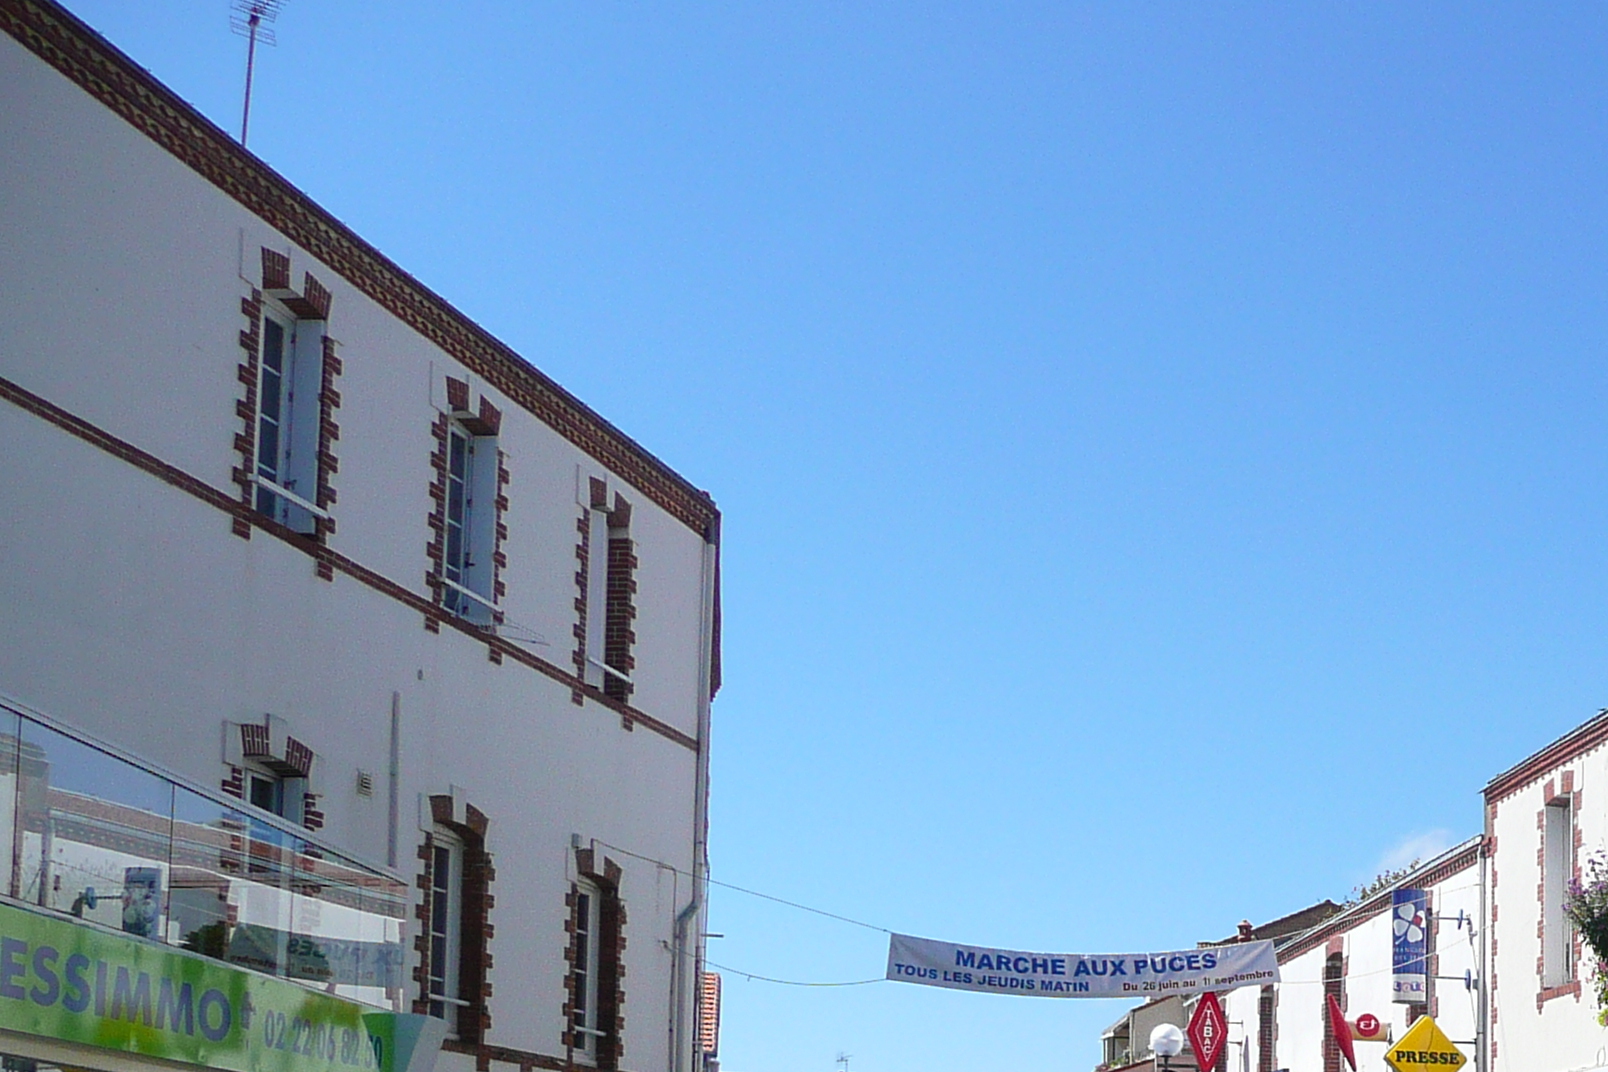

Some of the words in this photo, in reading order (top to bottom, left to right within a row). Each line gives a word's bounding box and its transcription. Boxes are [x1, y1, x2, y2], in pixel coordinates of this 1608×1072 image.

[895, 963, 939, 980] TOUS
[943, 970, 973, 984] LES
[977, 974, 1035, 990] JEUDIS
[1040, 980, 1089, 992] MATIN
[955, 950, 1066, 976] MARCHE
[1074, 959, 1127, 977] AUX
[1134, 953, 1217, 975] PUCES
[0, 936, 231, 1042] ESSIMMO
[1123, 982, 1138, 991] Du
[1158, 979, 1180, 993] juin
[1182, 980, 1196, 988] au
[1215, 970, 1274, 986] septembre
[1203, 1010, 1213, 1054] TABAC
[1395, 1050, 1460, 1065] PRESSE
